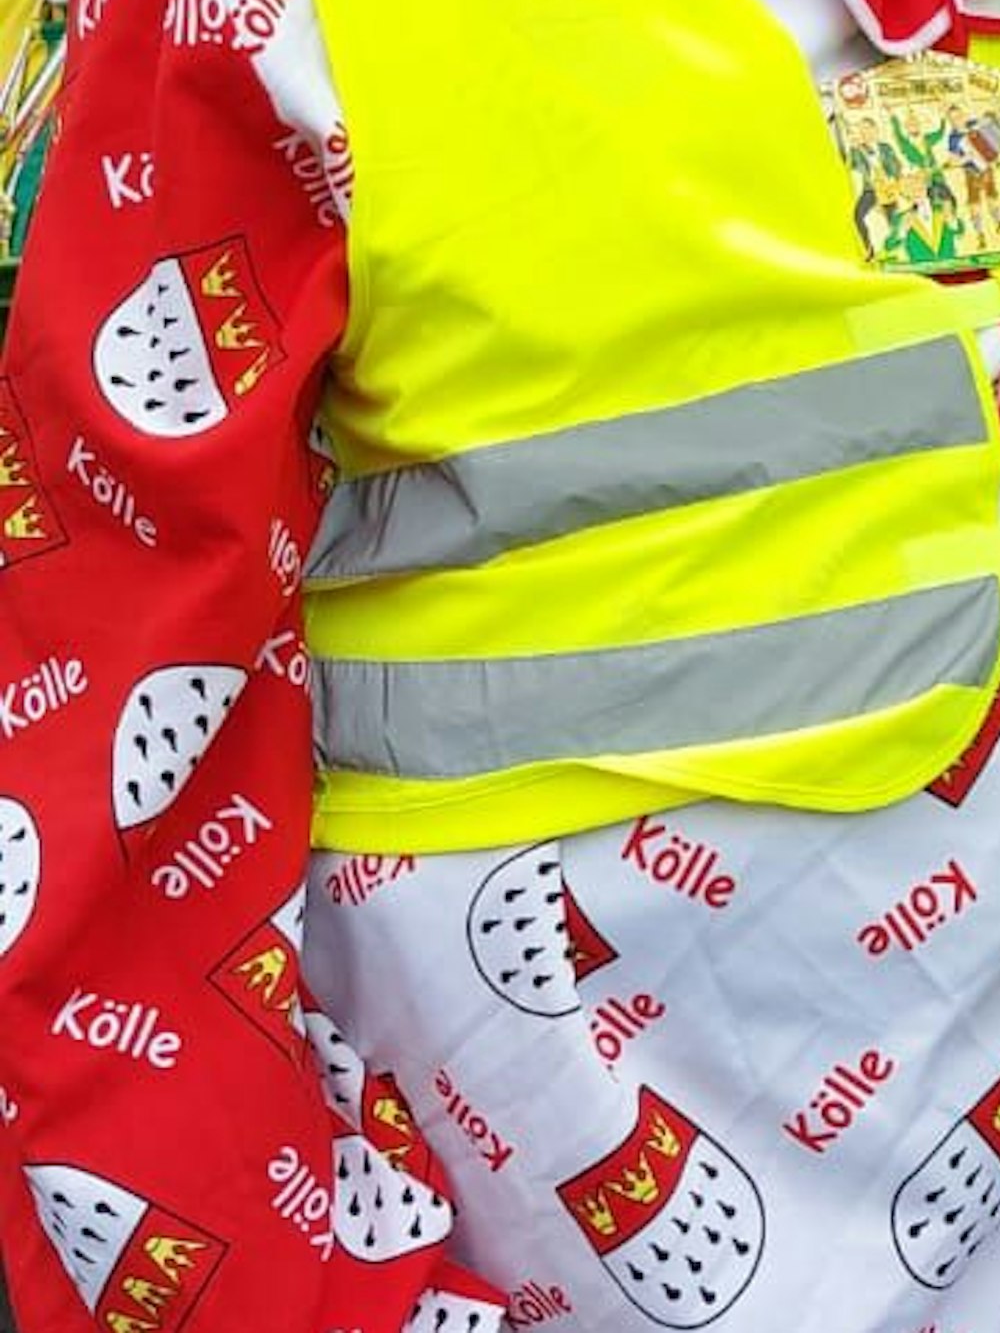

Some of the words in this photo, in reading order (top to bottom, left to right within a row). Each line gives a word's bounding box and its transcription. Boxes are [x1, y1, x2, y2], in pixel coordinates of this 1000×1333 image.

[67, 436, 157, 547] Kölle
[0, 657, 88, 738] Kölle
[151, 794, 272, 899] Kölle
[620, 814, 736, 909] Kölle
[857, 860, 977, 956] Kölle
[51, 988, 182, 1068] Kölle
[434, 1070, 513, 1172] Kölle
[782, 1050, 893, 1154] Kölle
